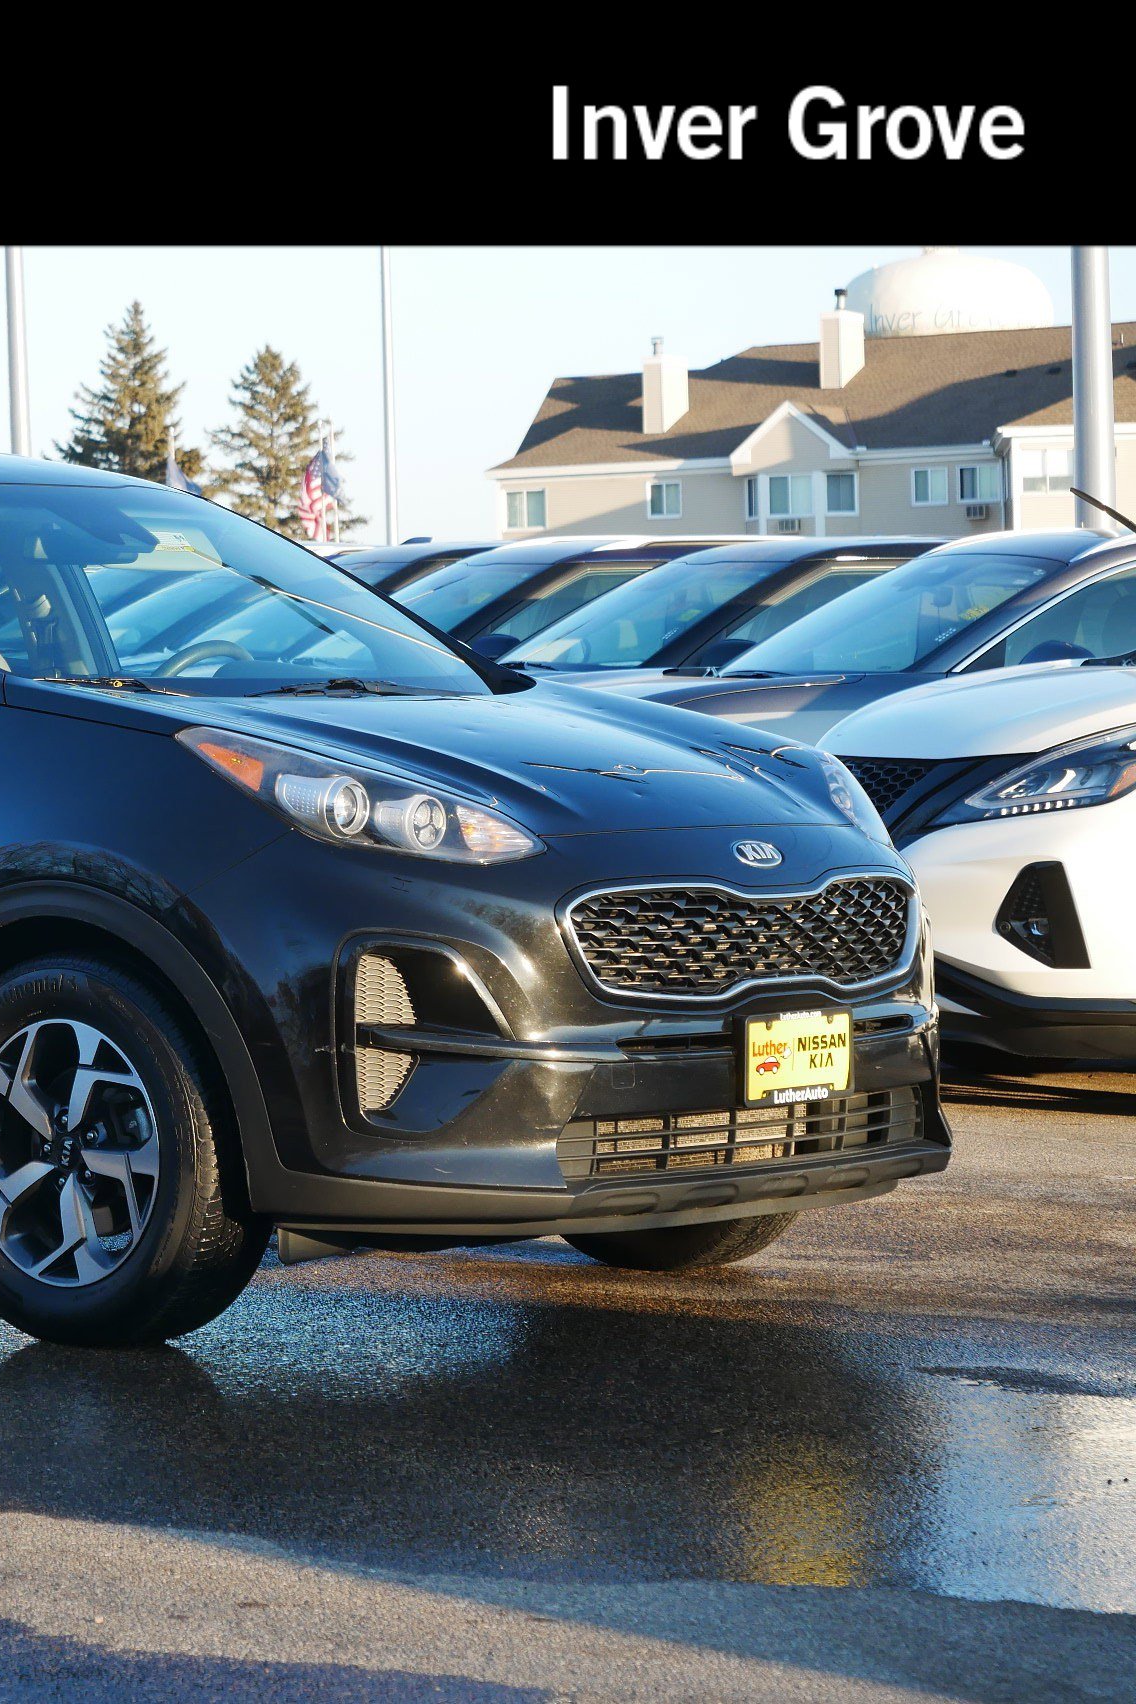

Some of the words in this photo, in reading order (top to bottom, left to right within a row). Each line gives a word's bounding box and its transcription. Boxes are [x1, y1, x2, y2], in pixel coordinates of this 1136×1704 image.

[869, 303, 922, 332] Inver
[737, 843, 779, 861] KIA
[752, 1040, 788, 1058] Luther
[797, 1033, 846, 1052] NISSAN
[809, 1052, 834, 1069] KIA
[774, 1086, 829, 1105] LutherAuto
